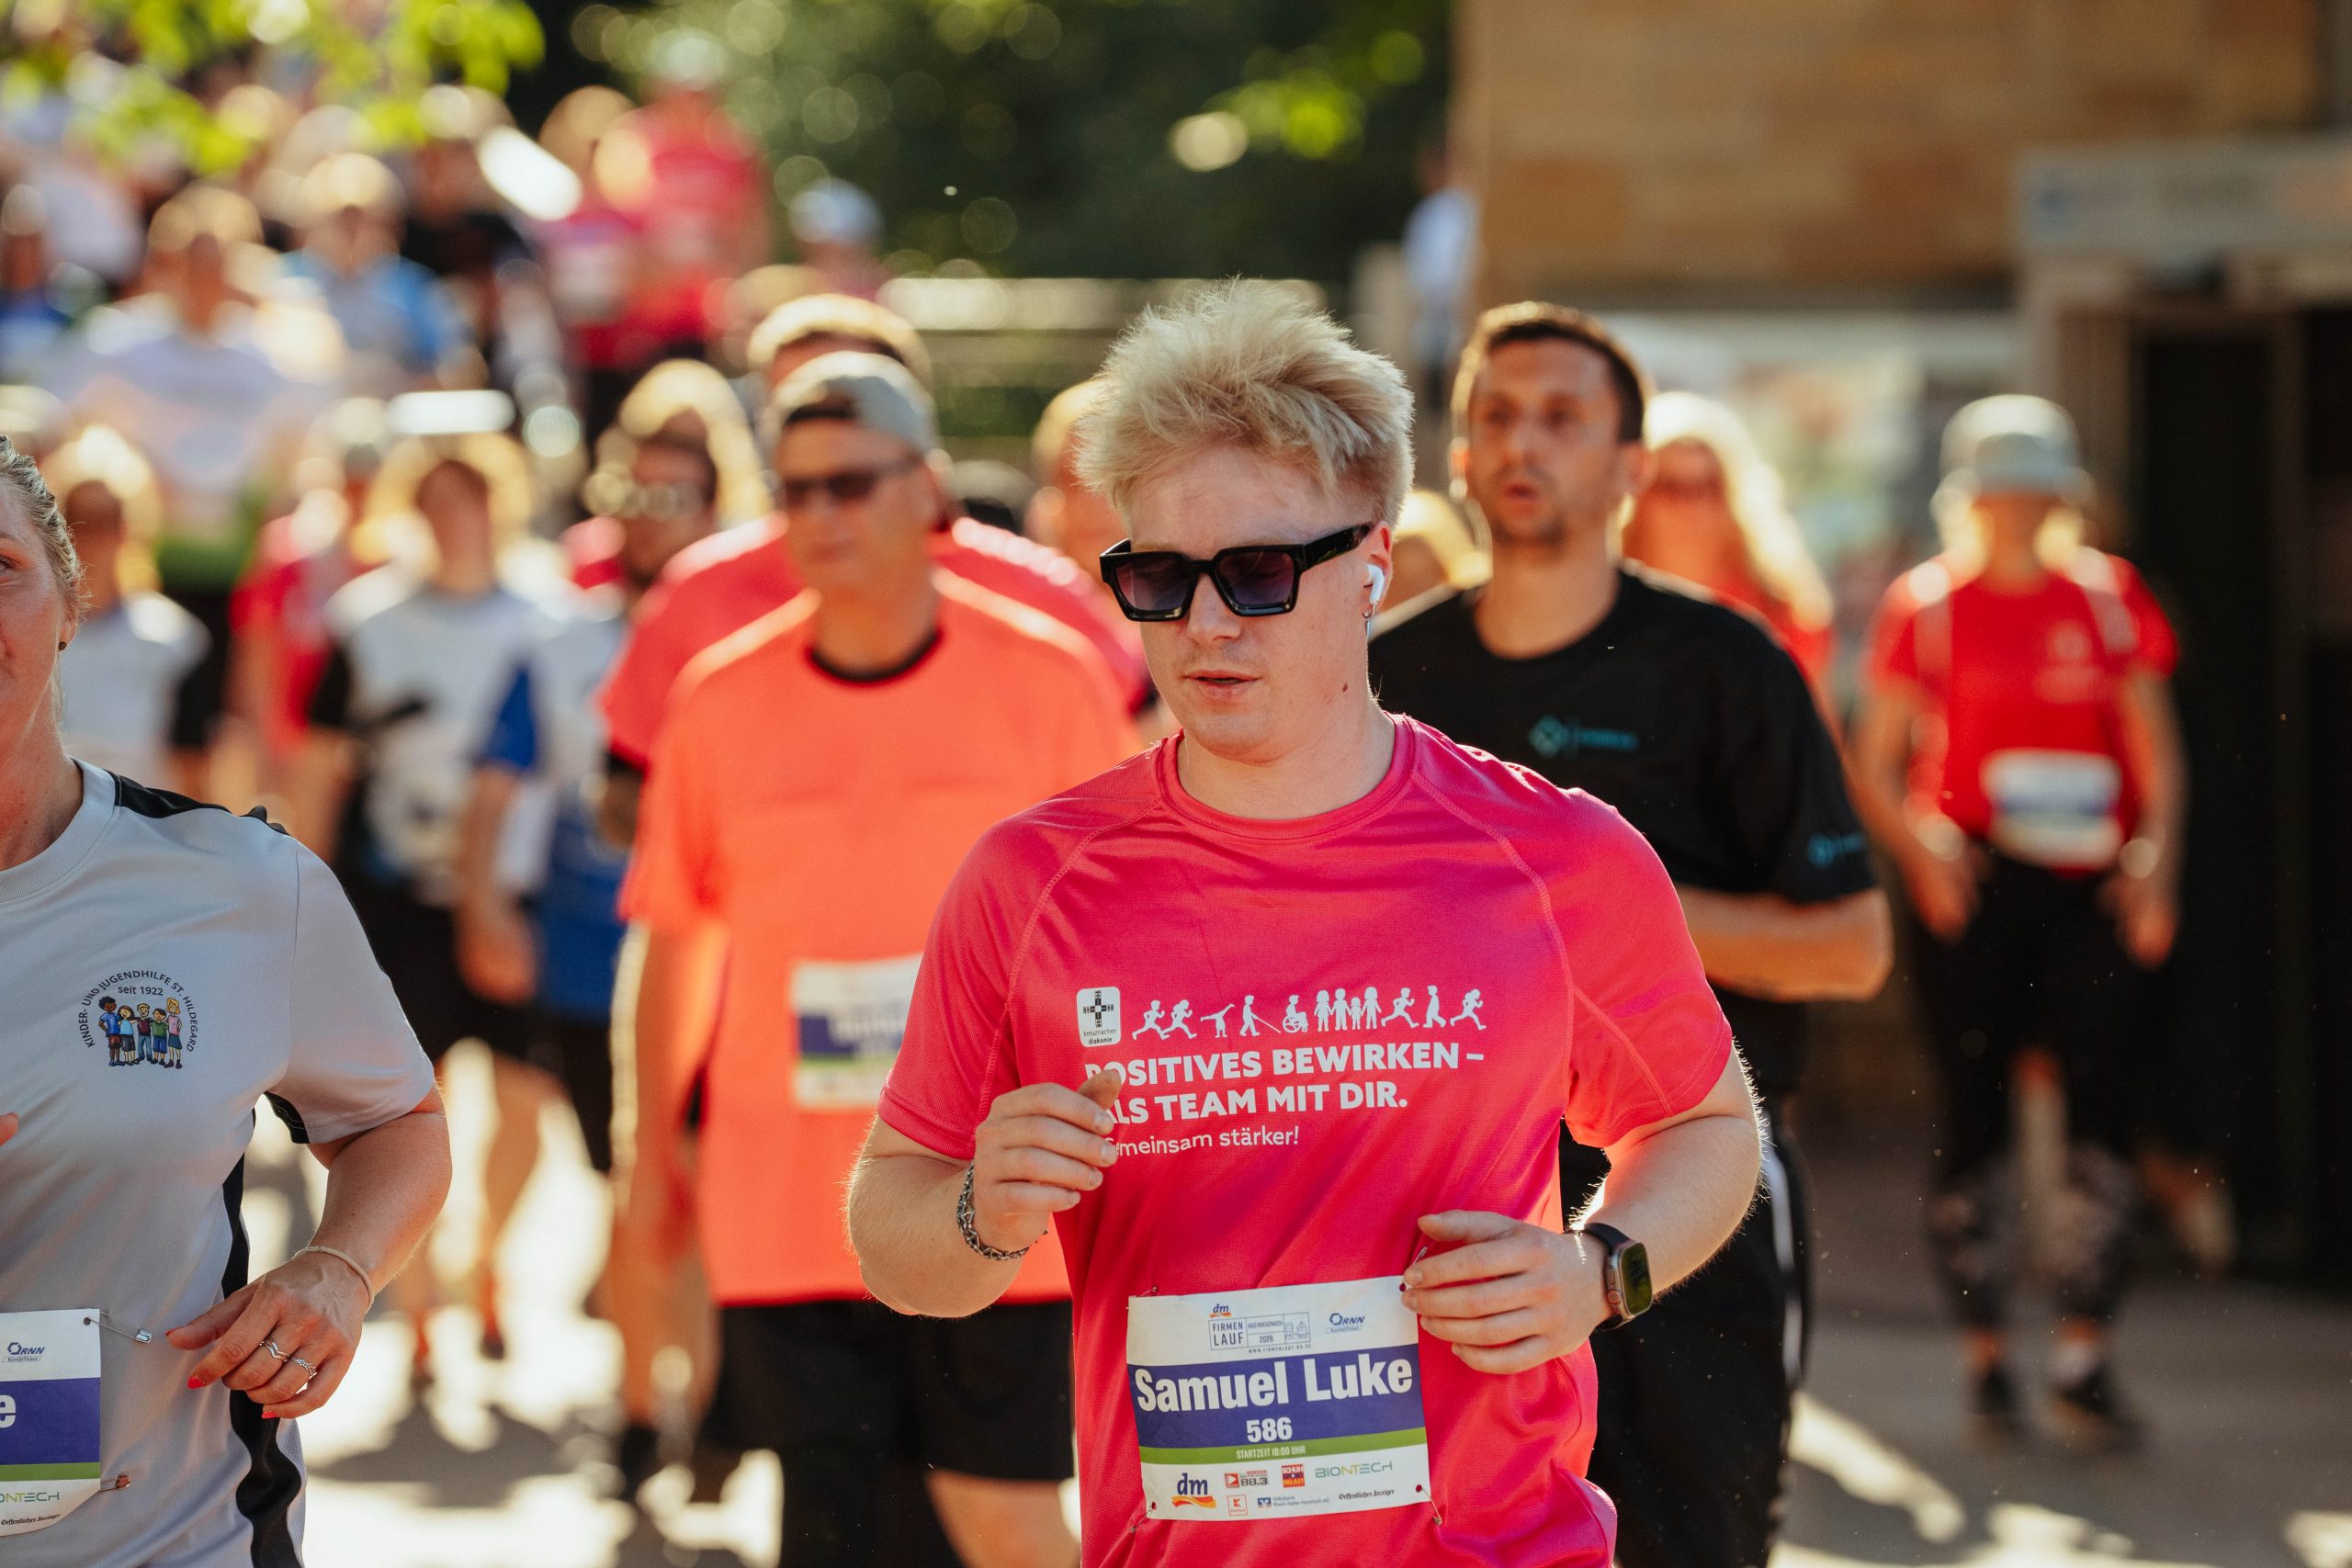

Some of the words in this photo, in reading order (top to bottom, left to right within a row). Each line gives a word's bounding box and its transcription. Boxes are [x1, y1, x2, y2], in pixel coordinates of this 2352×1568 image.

[98, 970, 172, 990] JUGENDHILFE
[81, 987, 100, 1006] UND
[118, 986, 136, 994] seit
[140, 986, 164, 996] 1922
[171, 982, 184, 997] ST.
[78, 1009, 96, 1048] KINDER-
[183, 996, 198, 1052] HILDEGARD
[1083, 1028, 1116, 1037] kreuznacher
[1272, 1043, 1459, 1075] BEWIRKEN
[1154, 1088, 1257, 1121] TEAM
[1267, 1084, 1330, 1112] MIT
[1340, 1081, 1408, 1109] DIR.
[1219, 1125, 1299, 1146] stärker!
[1213, 1303, 1229, 1314] dm
[1213, 1322, 1243, 1332] FIRMEN
[1214, 1332, 1244, 1346] LAUF
[20, 1347, 45, 1355] RNN
[1134, 1361, 1289, 1412] Samuel
[1303, 1353, 1413, 1402] Luke
[1246, 1416, 1293, 1443] 586
[1236, 1448, 1270, 1460] STARTZEIT
[1291, 1445, 1306, 1455] UHR
[1315, 1461, 1392, 1478] BIONTECH
[1177, 1472, 1208, 1495] dm
[1241, 1477, 1268, 1486] 88.3
